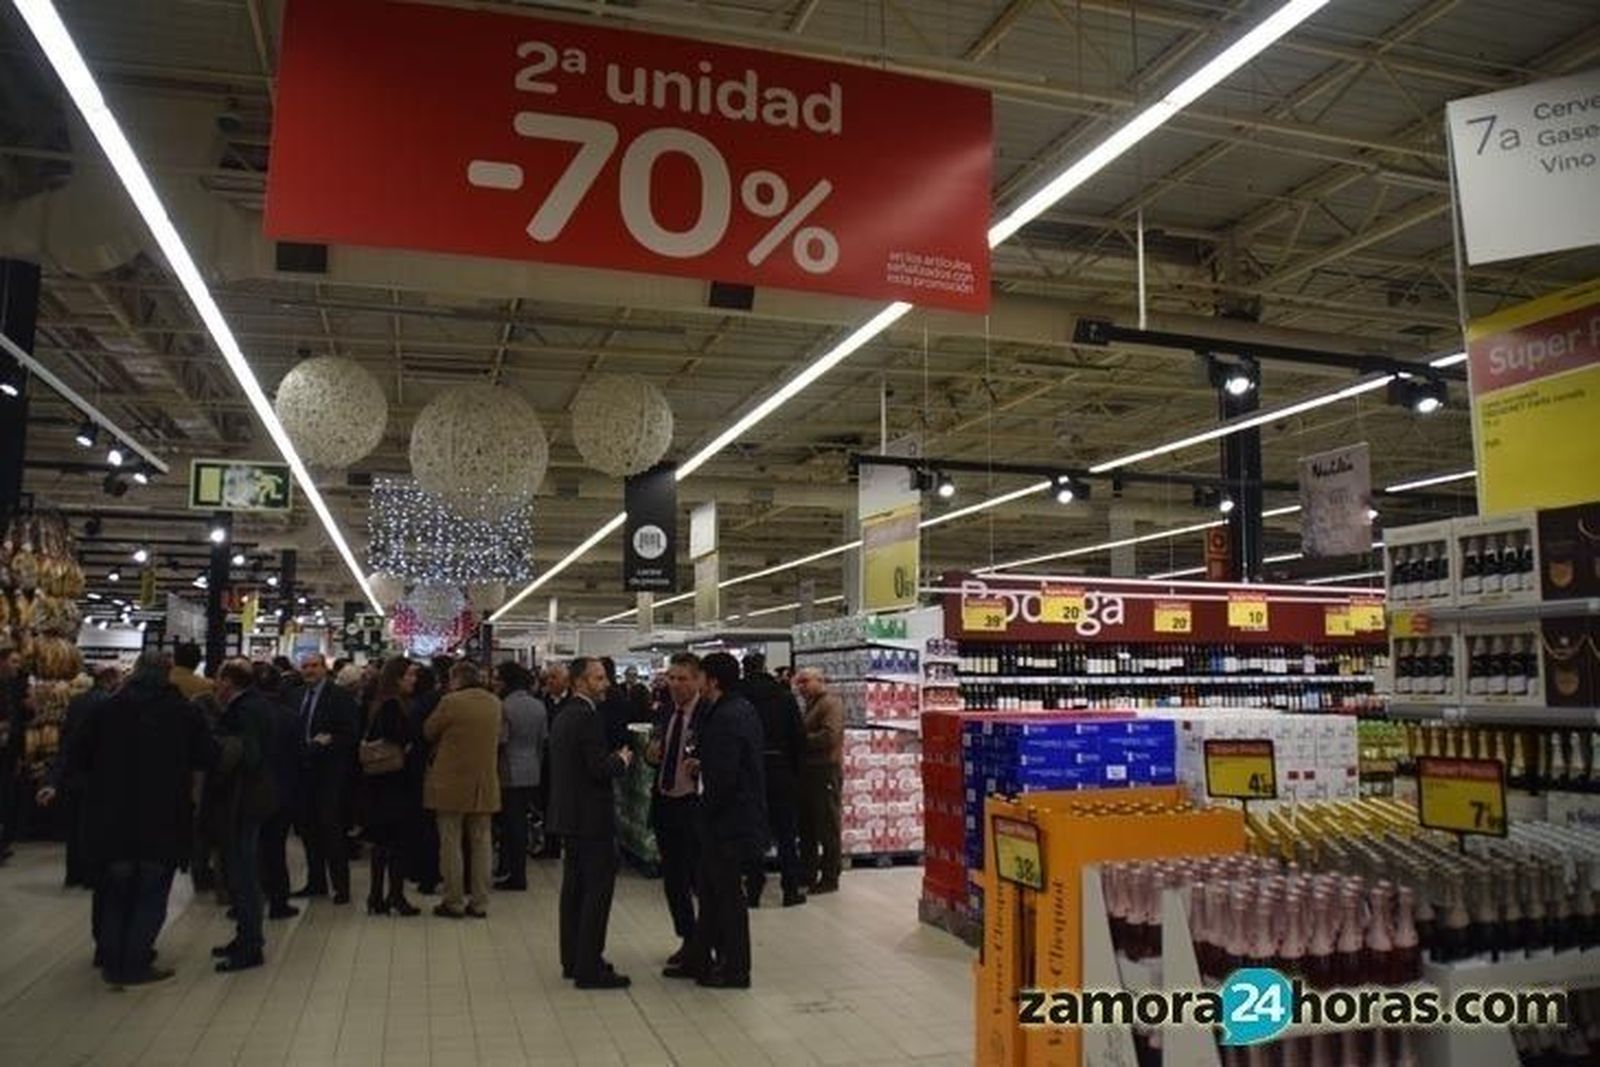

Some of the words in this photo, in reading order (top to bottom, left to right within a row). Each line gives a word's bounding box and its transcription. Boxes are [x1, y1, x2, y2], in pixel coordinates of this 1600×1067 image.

[514, 41, 588, 95] 2ª
[606, 61, 843, 135] unidad
[467, 111, 841, 275] -70%
[1541, 152, 1597, 174] Vino
[1489, 326, 1582, 376] Super
